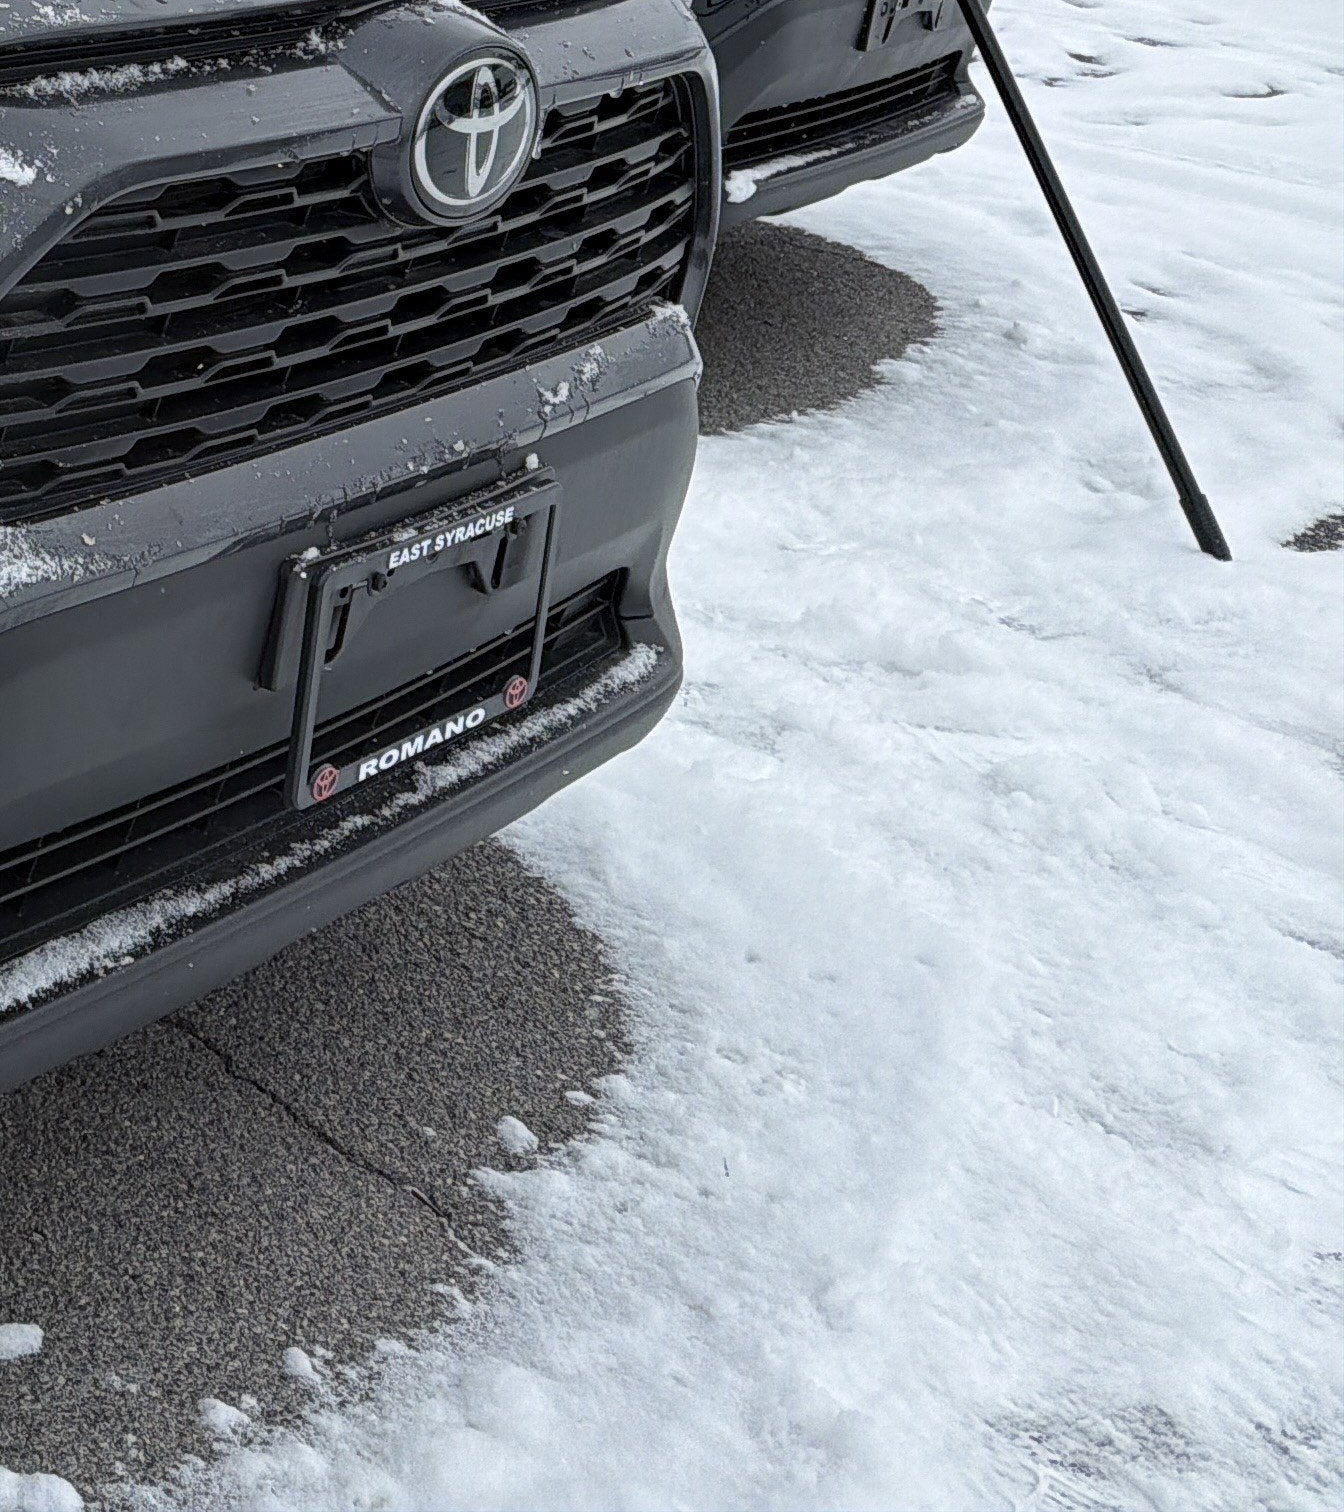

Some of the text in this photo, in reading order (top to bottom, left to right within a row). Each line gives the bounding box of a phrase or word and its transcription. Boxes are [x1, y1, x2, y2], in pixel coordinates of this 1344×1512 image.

[388, 506, 515, 569] EAST SYRACUSE
[358, 708, 486, 782] ROMANO
